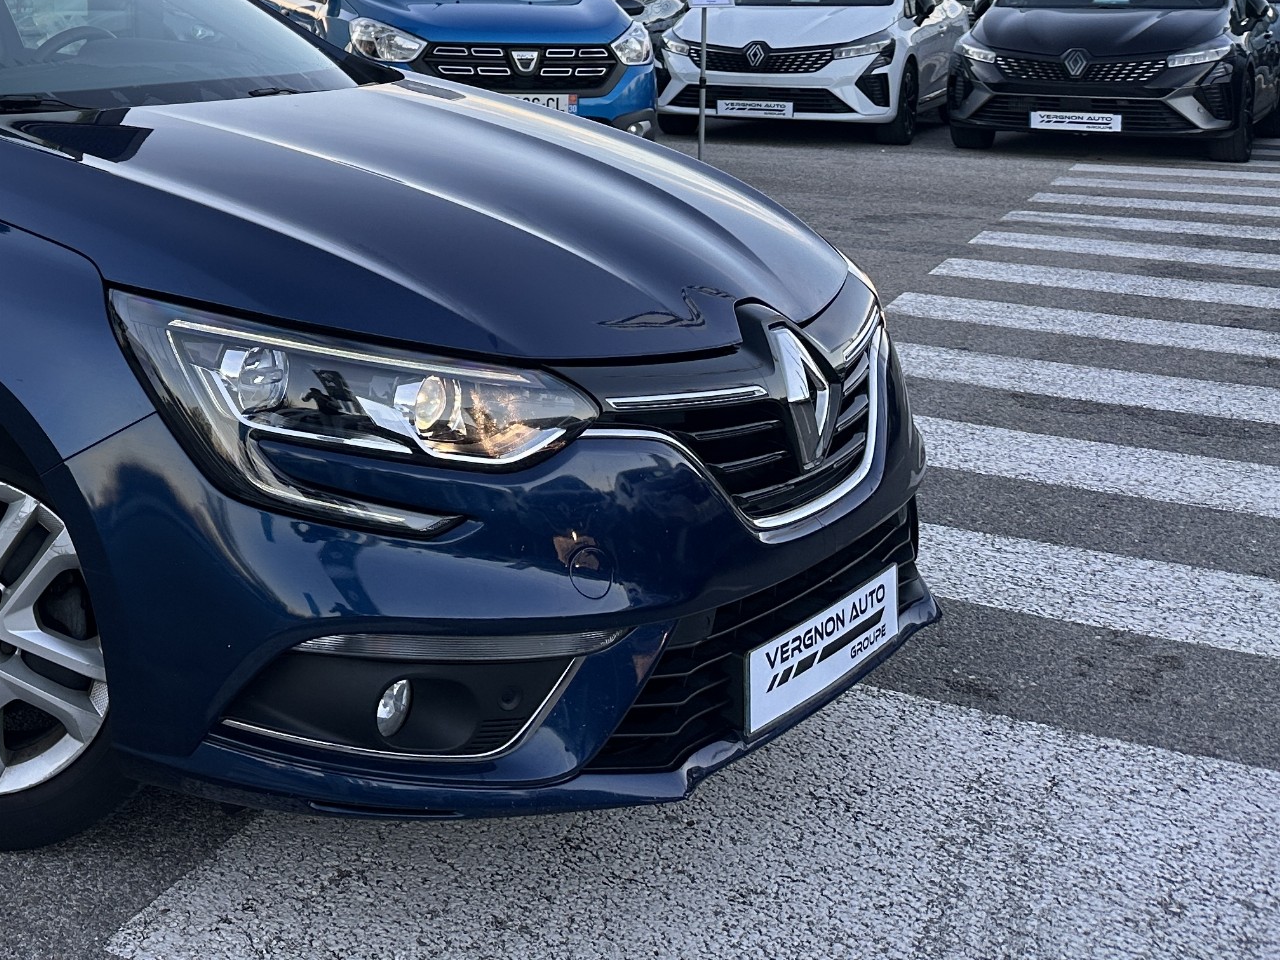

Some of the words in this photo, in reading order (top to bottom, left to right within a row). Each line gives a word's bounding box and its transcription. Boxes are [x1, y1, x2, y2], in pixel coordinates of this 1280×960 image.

[568, 104, 578, 113] 30
[765, 608, 845, 670] VERGNON
[849, 583, 886, 624] AUTO
[850, 623, 886, 660] GROUPE
